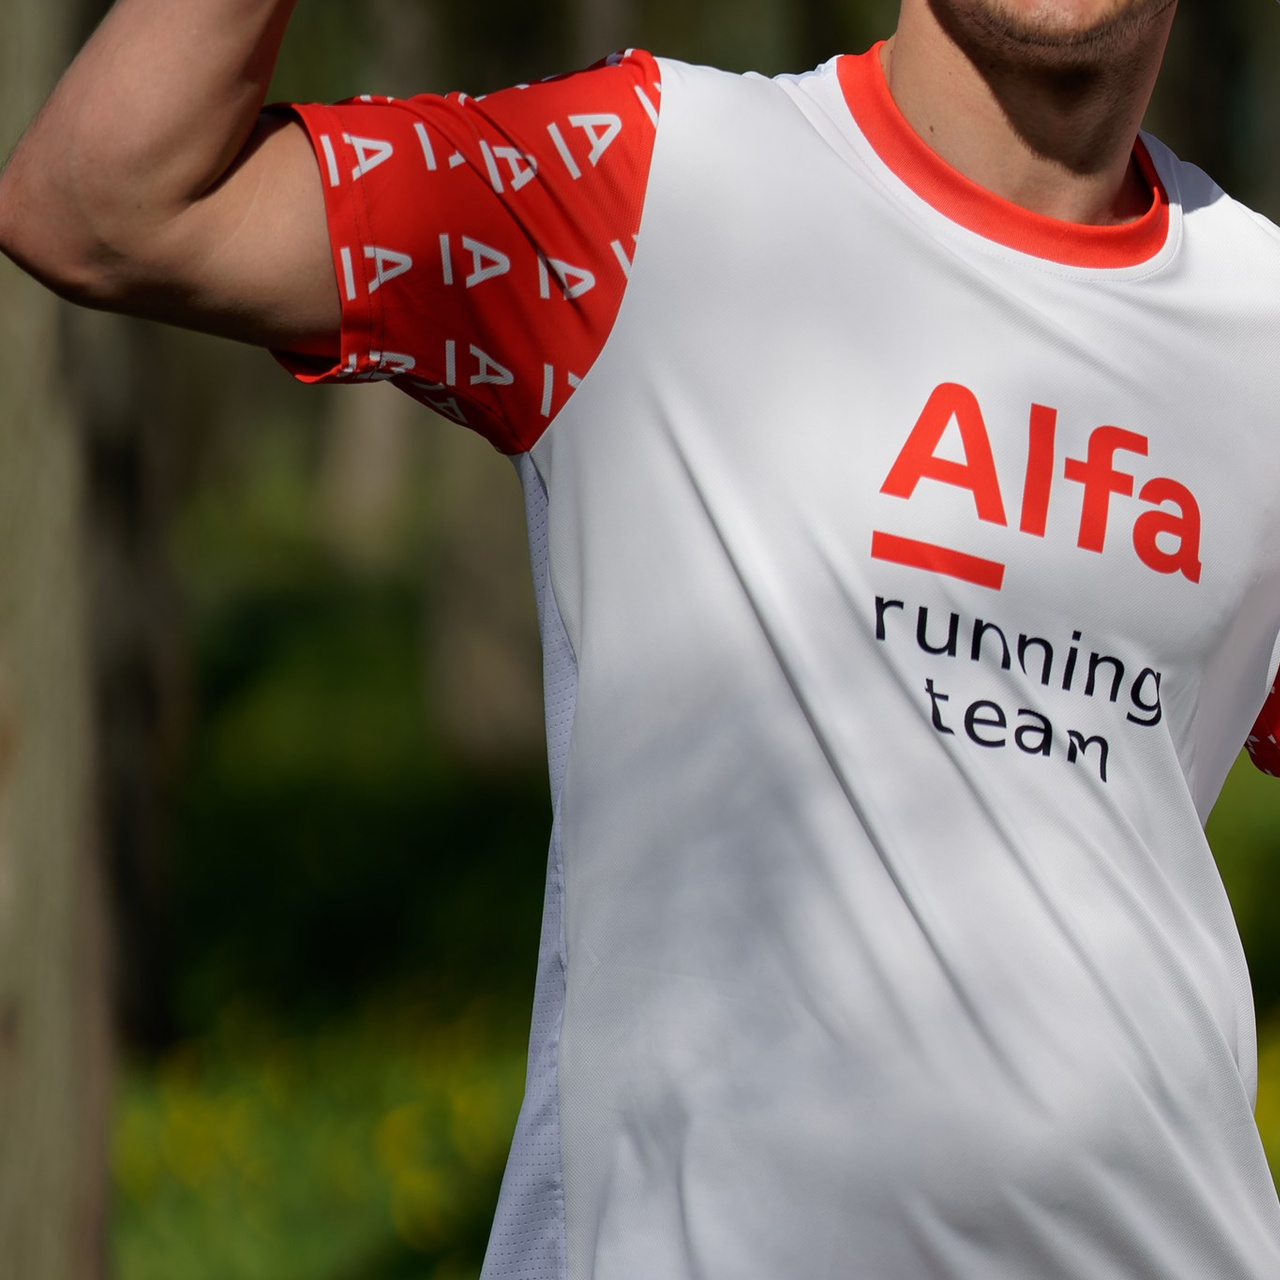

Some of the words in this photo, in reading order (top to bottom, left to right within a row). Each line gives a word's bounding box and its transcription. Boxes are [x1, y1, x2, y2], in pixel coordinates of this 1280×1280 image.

[879, 381, 1202, 584] Alfa
[874, 595, 1163, 726] running
[924, 678, 1110, 783] team
